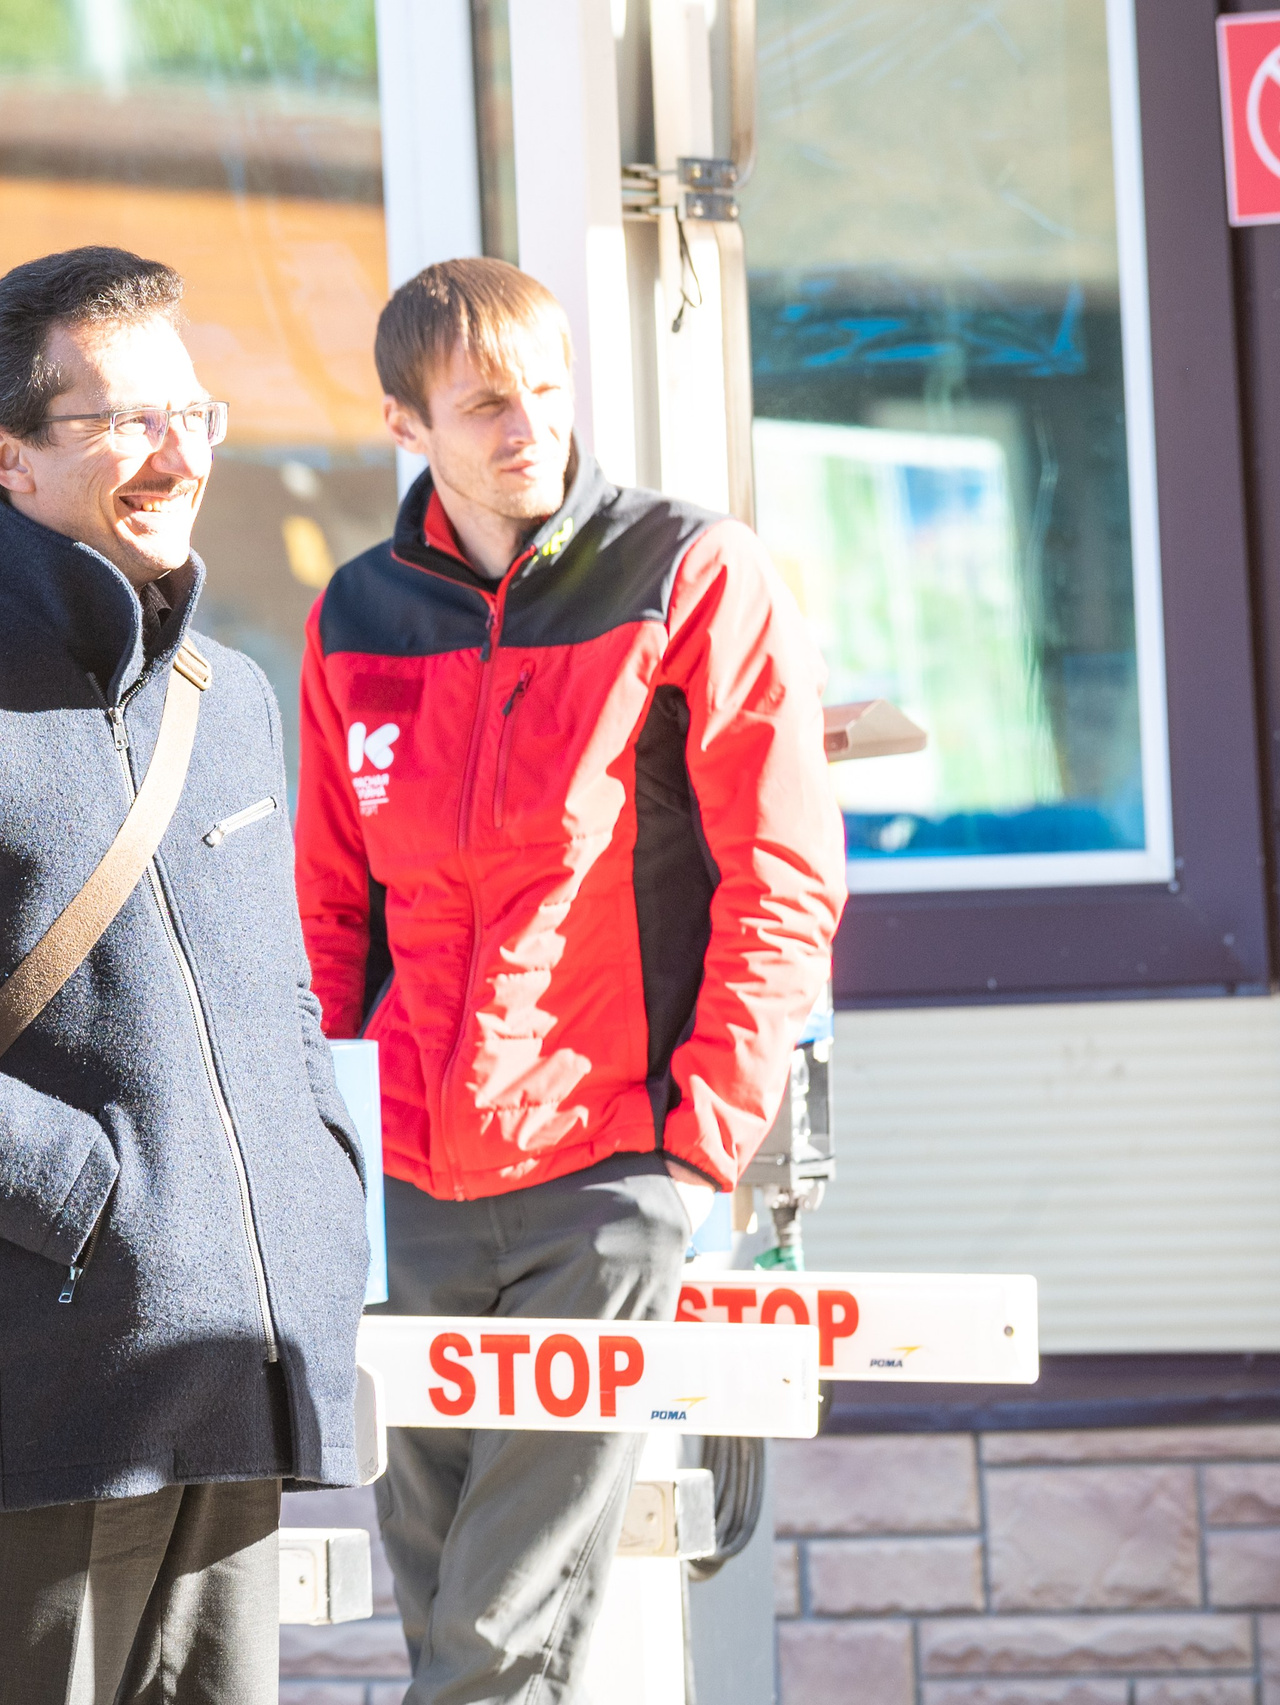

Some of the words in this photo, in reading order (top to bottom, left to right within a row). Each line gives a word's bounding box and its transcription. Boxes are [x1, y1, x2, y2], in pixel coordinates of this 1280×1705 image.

[869, 1358, 903, 1368] POMA
[428, 1332, 645, 1418] STOP
[650, 1410, 687, 1420] POMA
